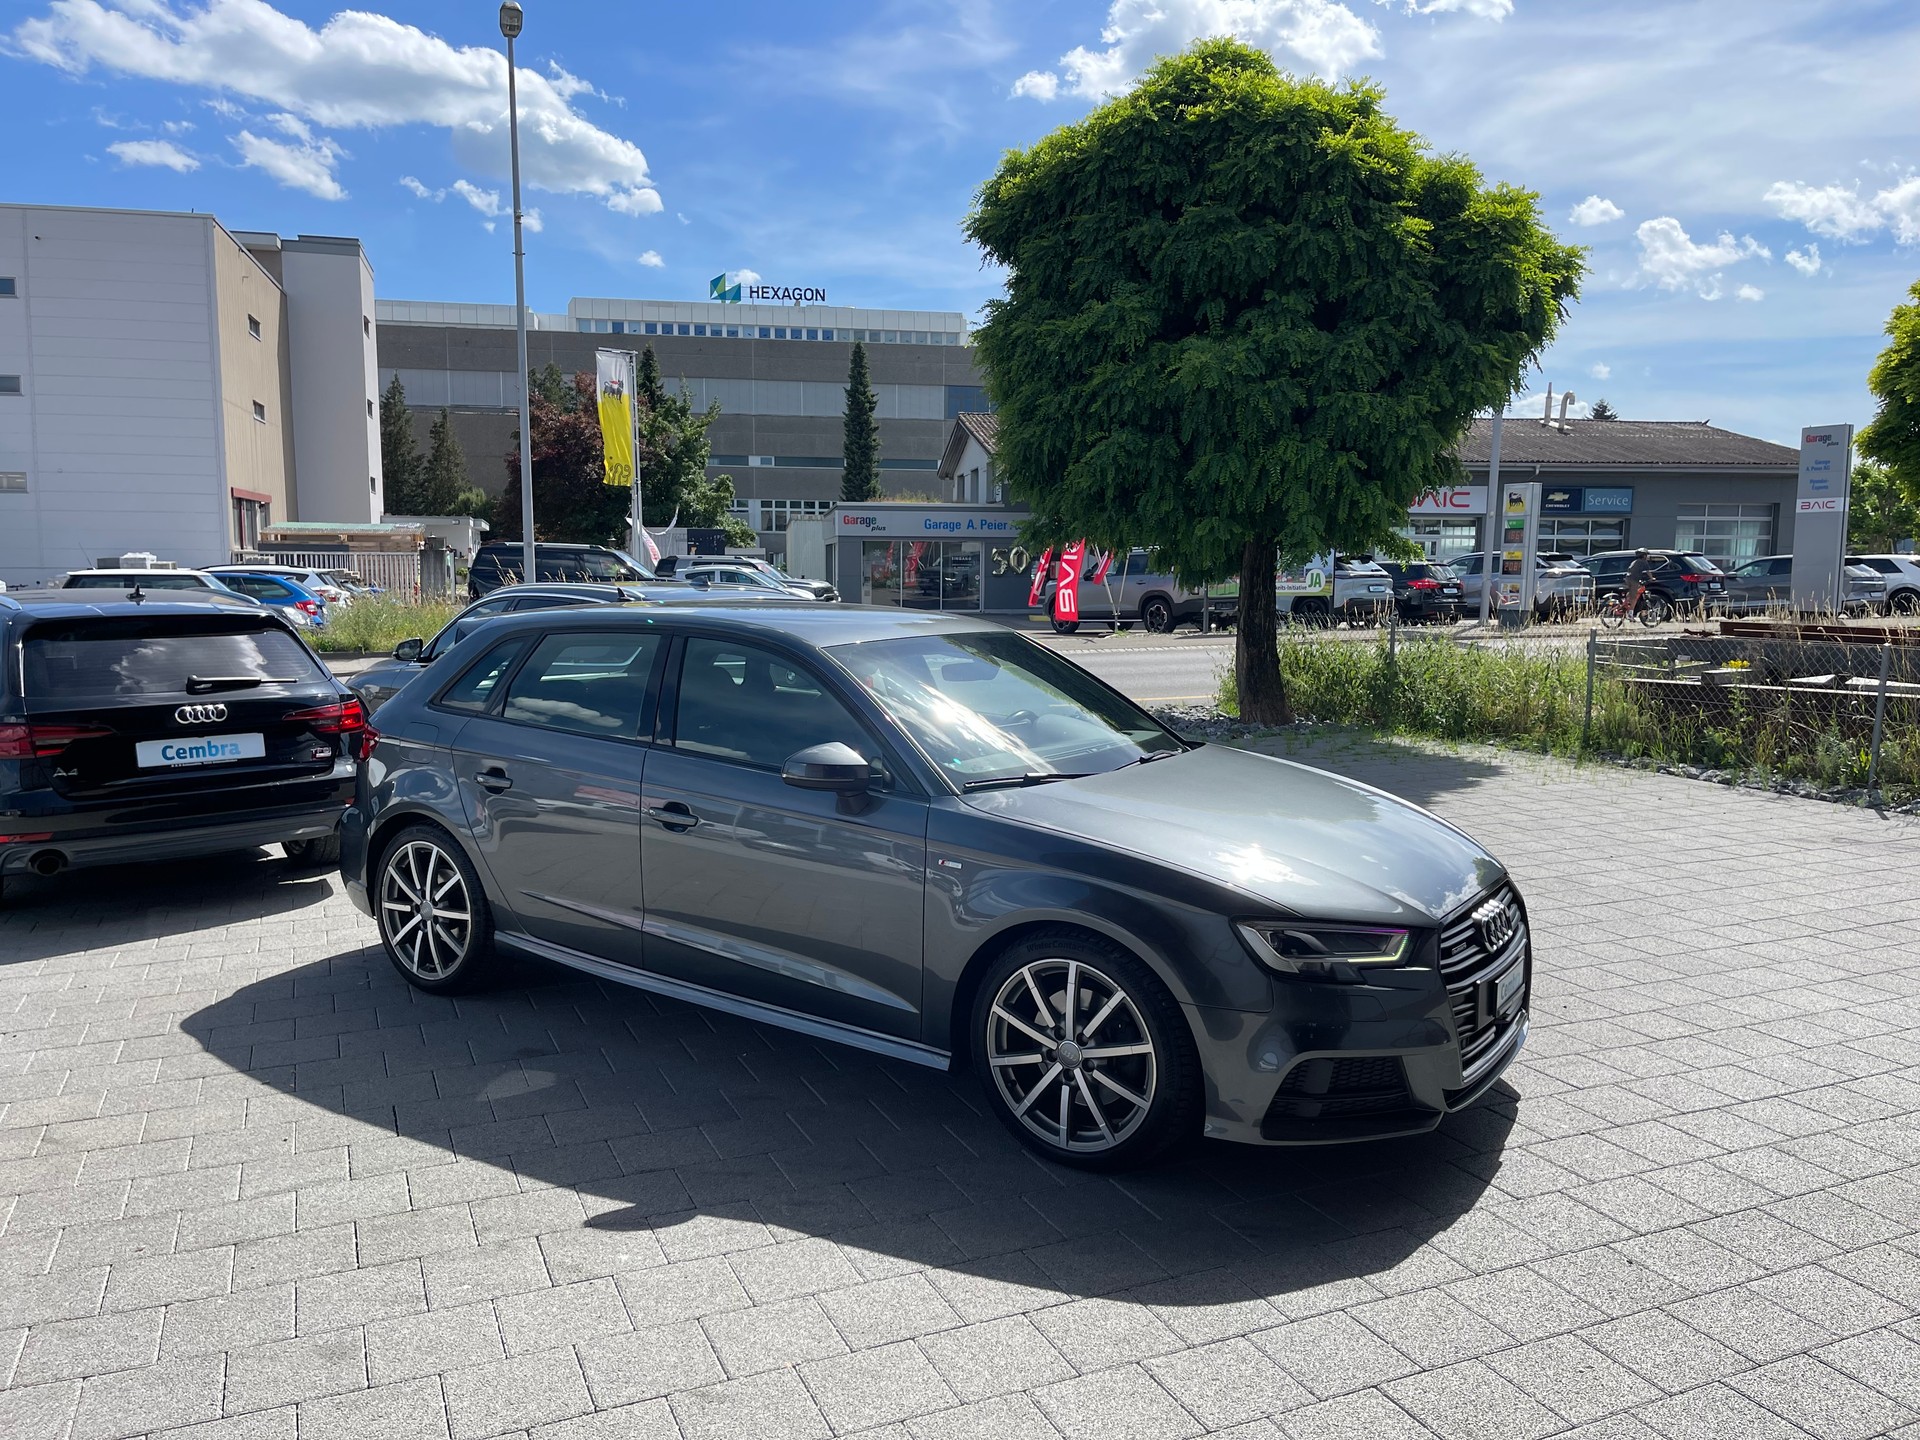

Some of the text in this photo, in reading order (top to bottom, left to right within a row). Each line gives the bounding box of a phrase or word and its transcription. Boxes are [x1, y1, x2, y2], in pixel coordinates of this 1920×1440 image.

[749, 285, 826, 302] HEXAGON
[1805, 434, 1832, 444] Garage
[1588, 494, 1629, 506] Service
[1800, 500, 1836, 510] BAIC
[843, 514, 877, 528] Garage
[871, 524, 887, 532] plus
[924, 518, 962, 532] Garage
[966, 518, 977, 530] A.
[980, 518, 1008, 531] Peier
[991, 546, 1030, 576] 50
[1308, 572, 1322, 588] JA
[161, 740, 241, 761] Cembra
[52, 767, 78, 778] A4
